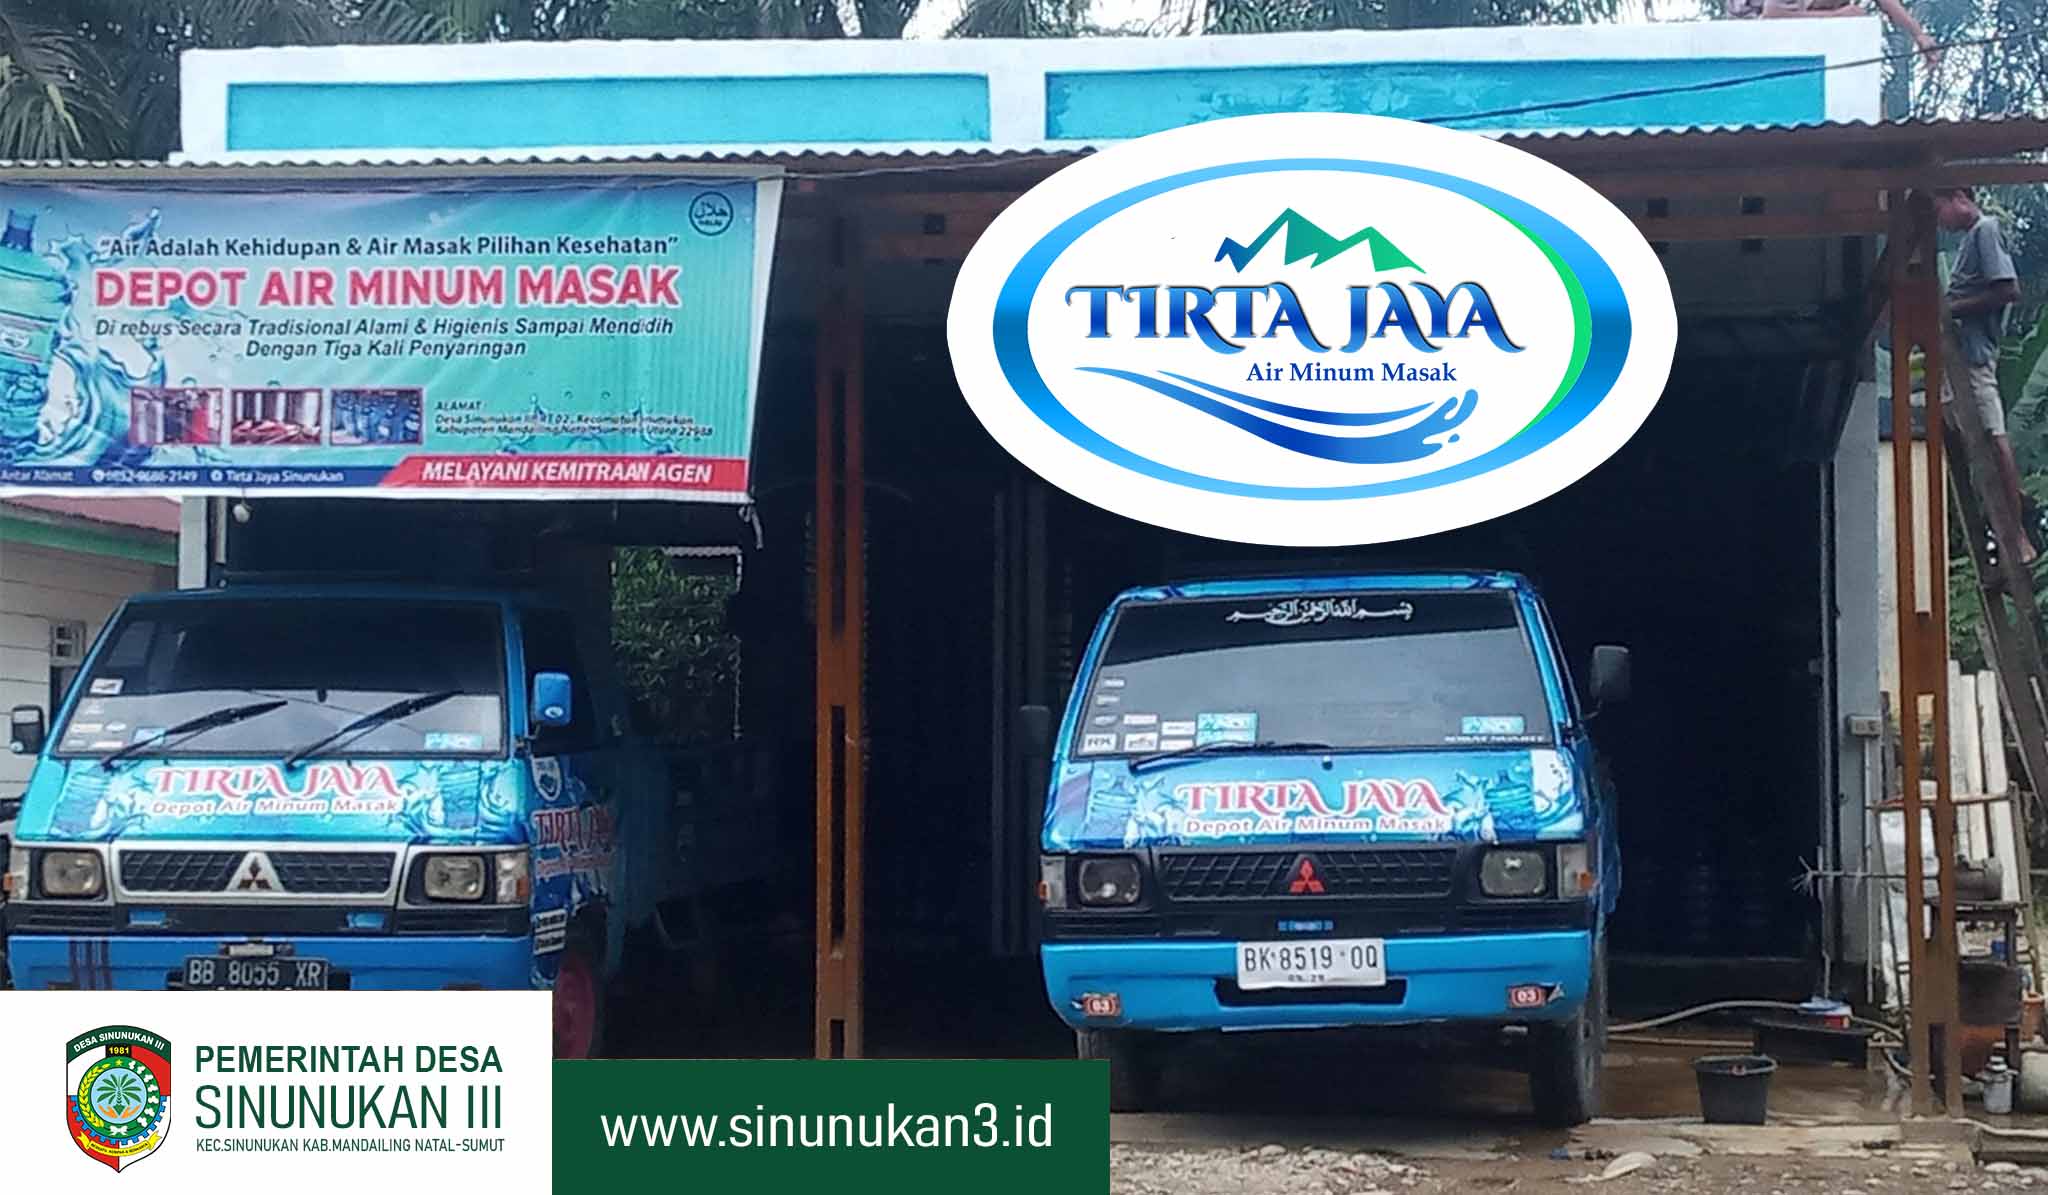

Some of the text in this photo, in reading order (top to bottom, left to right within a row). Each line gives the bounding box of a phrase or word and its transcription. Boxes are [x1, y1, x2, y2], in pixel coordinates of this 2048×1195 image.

[145, 238, 219, 257] Adalah
[225, 238, 339, 260] Kehidupan
[347, 241, 361, 257] &
[367, 239, 399, 256] Air
[403, 237, 471, 256] Masak
[477, 236, 551, 256] Pilihan
[96, 268, 681, 307] DEPOT AIR MINUM MASAK
[96, 317, 673, 338] Di rebus Secara Tradisional Alami & Higienis Sampai Mendidih
[246, 340, 526, 361] Dengan Tiga Kali Penyaringan
[422, 462, 711, 483] MELAYANI KEMITRAAN AGEN
[153, 766, 402, 798] TIRTA JAYA
[152, 801, 398, 816] Depot Air Minum Masak
[1177, 780, 1449, 815] TIRTA JAYA
[1187, 818, 1446, 836] Depot Air Minum Masak
[1244, 946, 1271, 972] BK
[1279, 944, 1333, 971] 8519
[189, 959, 322, 987] BB 8055 XR
